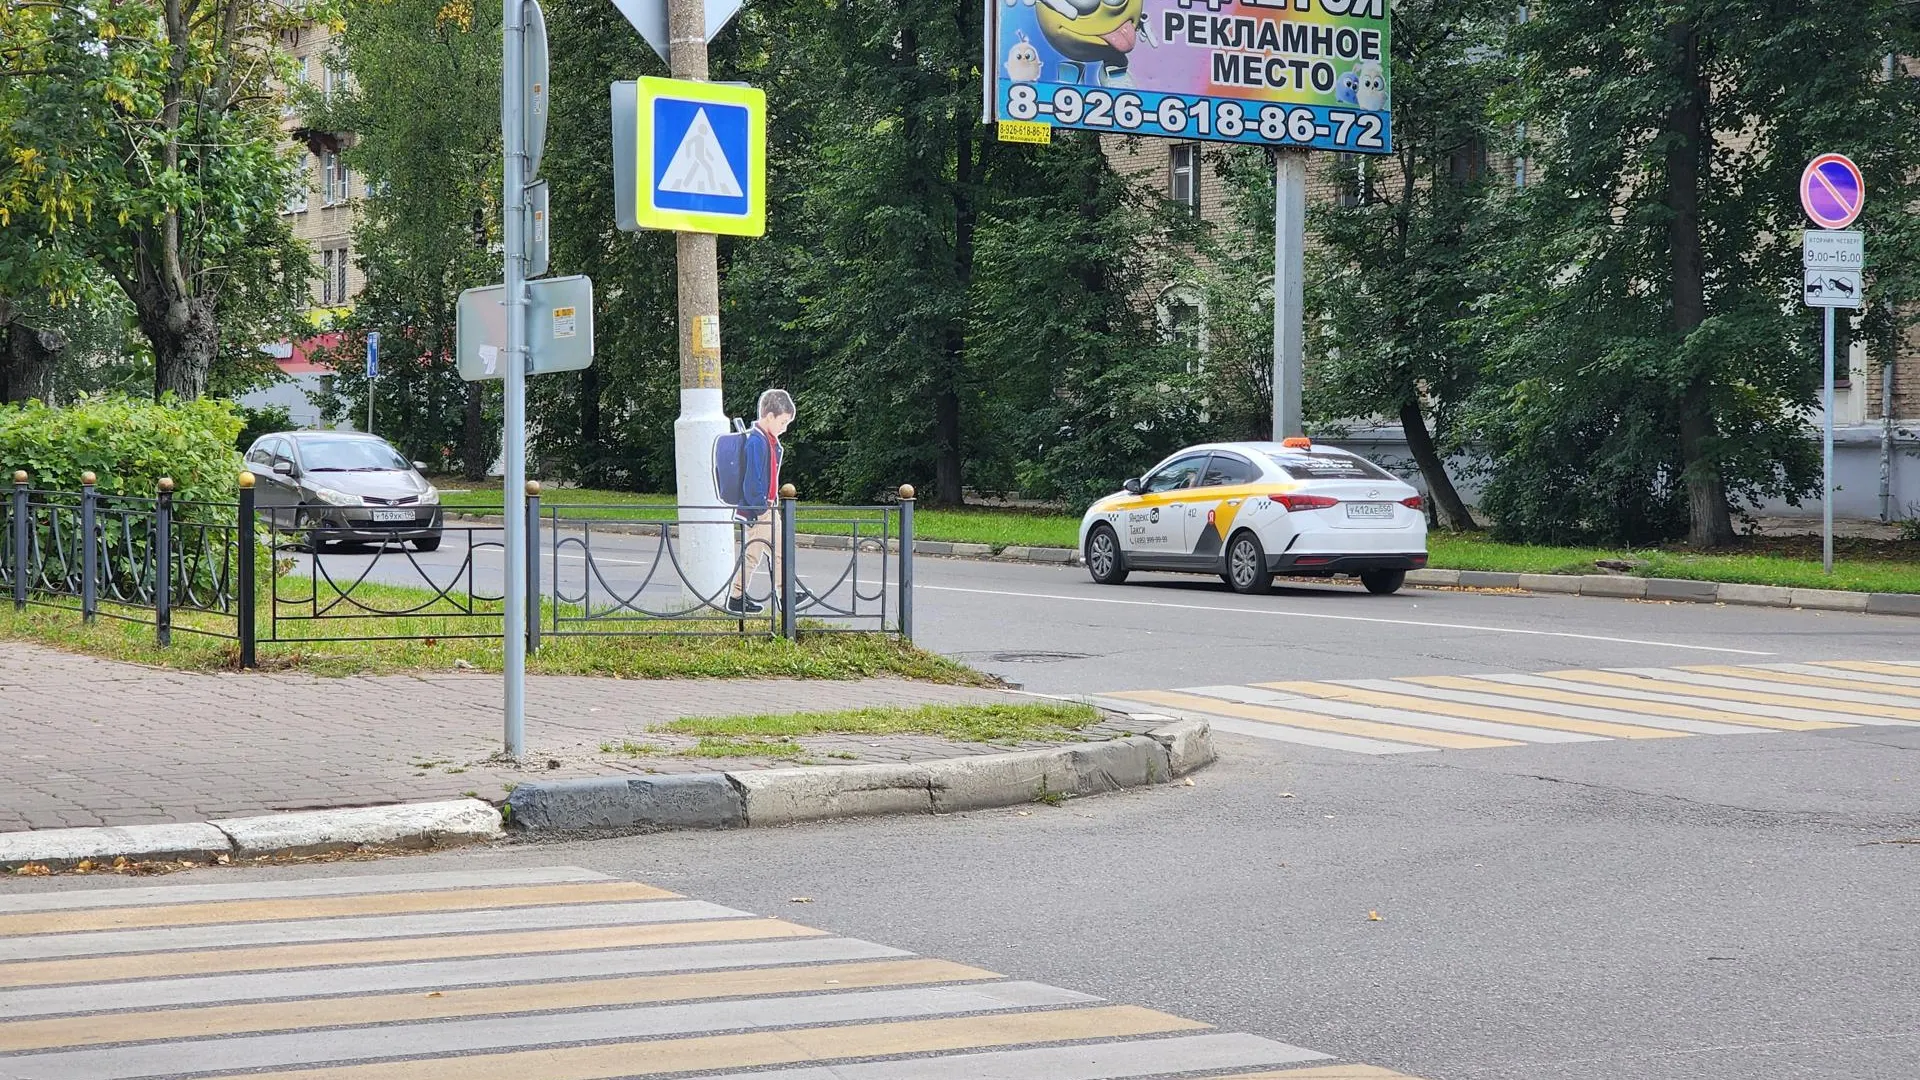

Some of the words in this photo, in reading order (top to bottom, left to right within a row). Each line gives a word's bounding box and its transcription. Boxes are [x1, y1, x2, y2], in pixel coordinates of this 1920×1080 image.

[1165, 12, 1380, 60] РЕКЛАМНОЕ
[1213, 53, 1334, 91] МЕСТО
[1007, 83, 1383, 147] 8-926-618-86-72
[1000, 124, 1050, 137] 8-926-618-86-72
[1808, 250, 1860, 262] 9.00-16.00
[1188, 508, 1197, 517] 412
[1130, 525, 1145, 535] Такси
